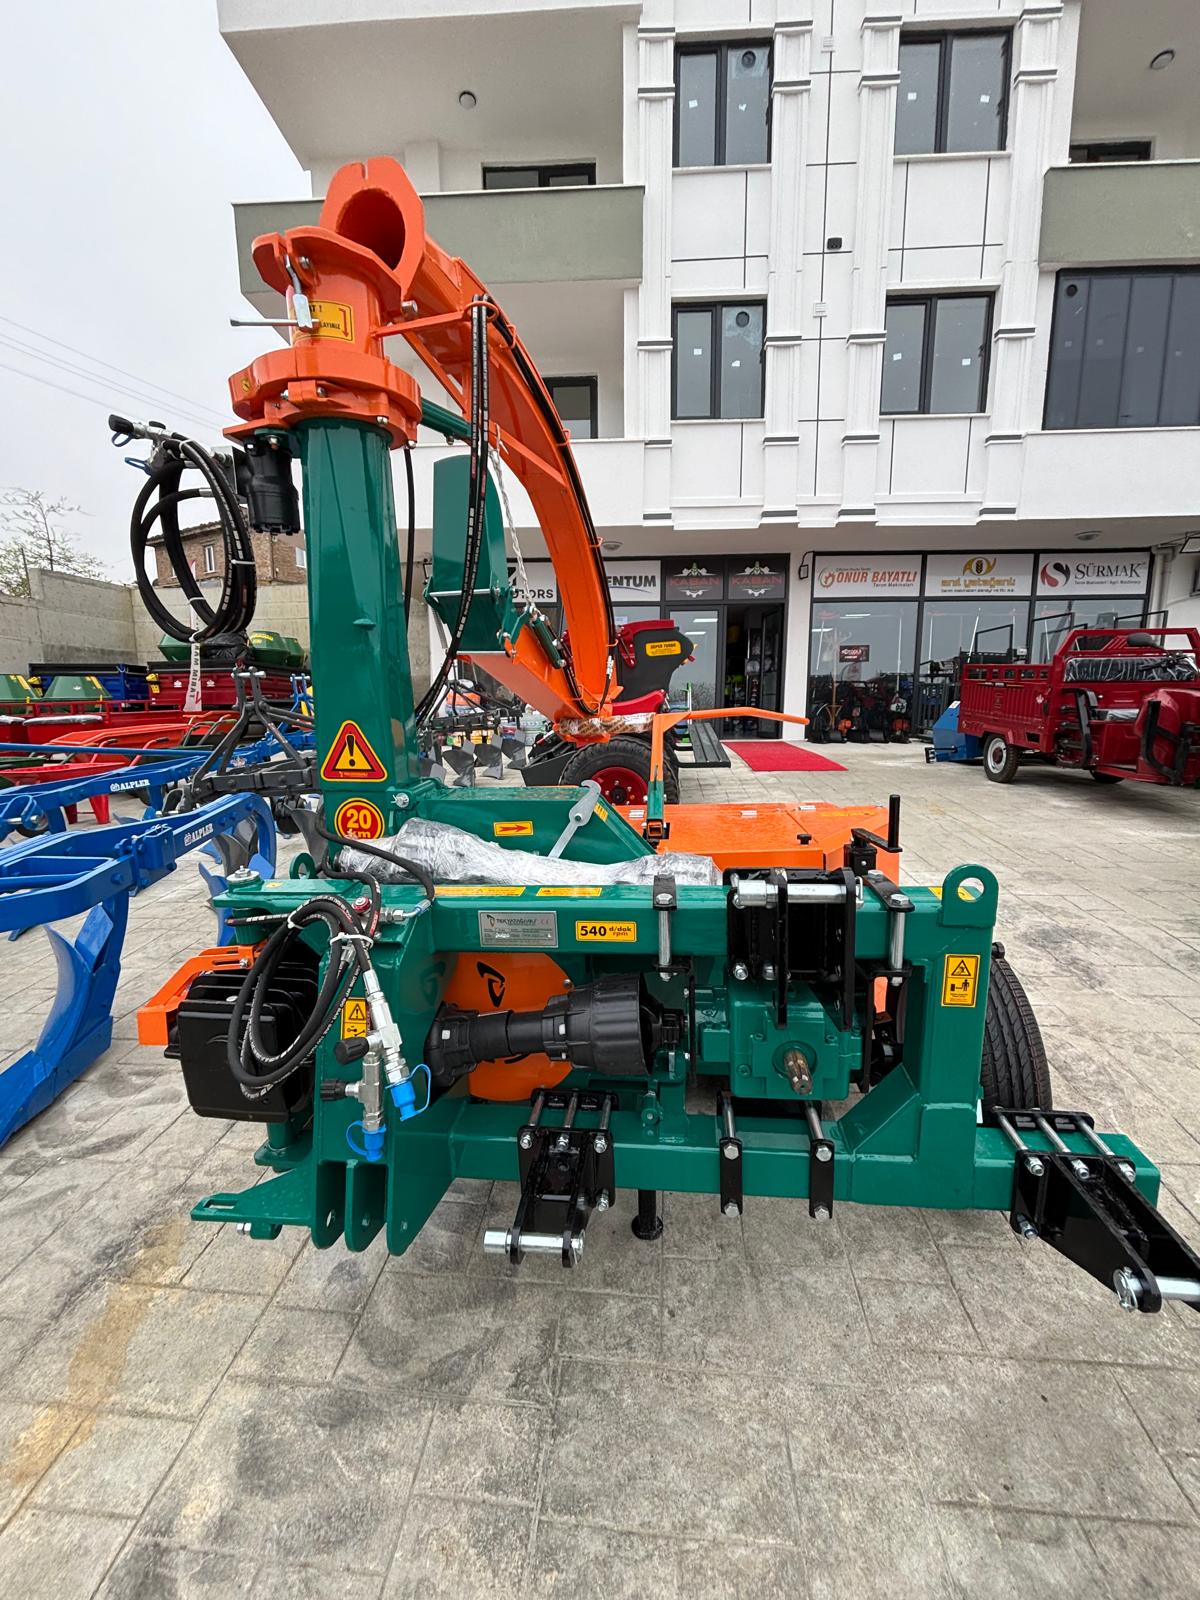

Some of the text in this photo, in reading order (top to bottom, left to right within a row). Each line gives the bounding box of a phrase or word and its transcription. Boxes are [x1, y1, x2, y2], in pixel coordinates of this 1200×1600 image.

[836, 571, 918, 583] ONUR BAYATLI
[1075, 563, 1141, 580] SÜRMAK
[607, 575, 657, 587] ENTUM
[669, 577, 720, 586] KABAN
[731, 577, 782, 585] KABAN
[512, 588, 554, 599] OTORS
[120, 779, 150, 790] ALPLER
[346, 808, 372, 829] 20
[191, 823, 214, 843] ALPLER
[580, 925, 607, 937] 540
